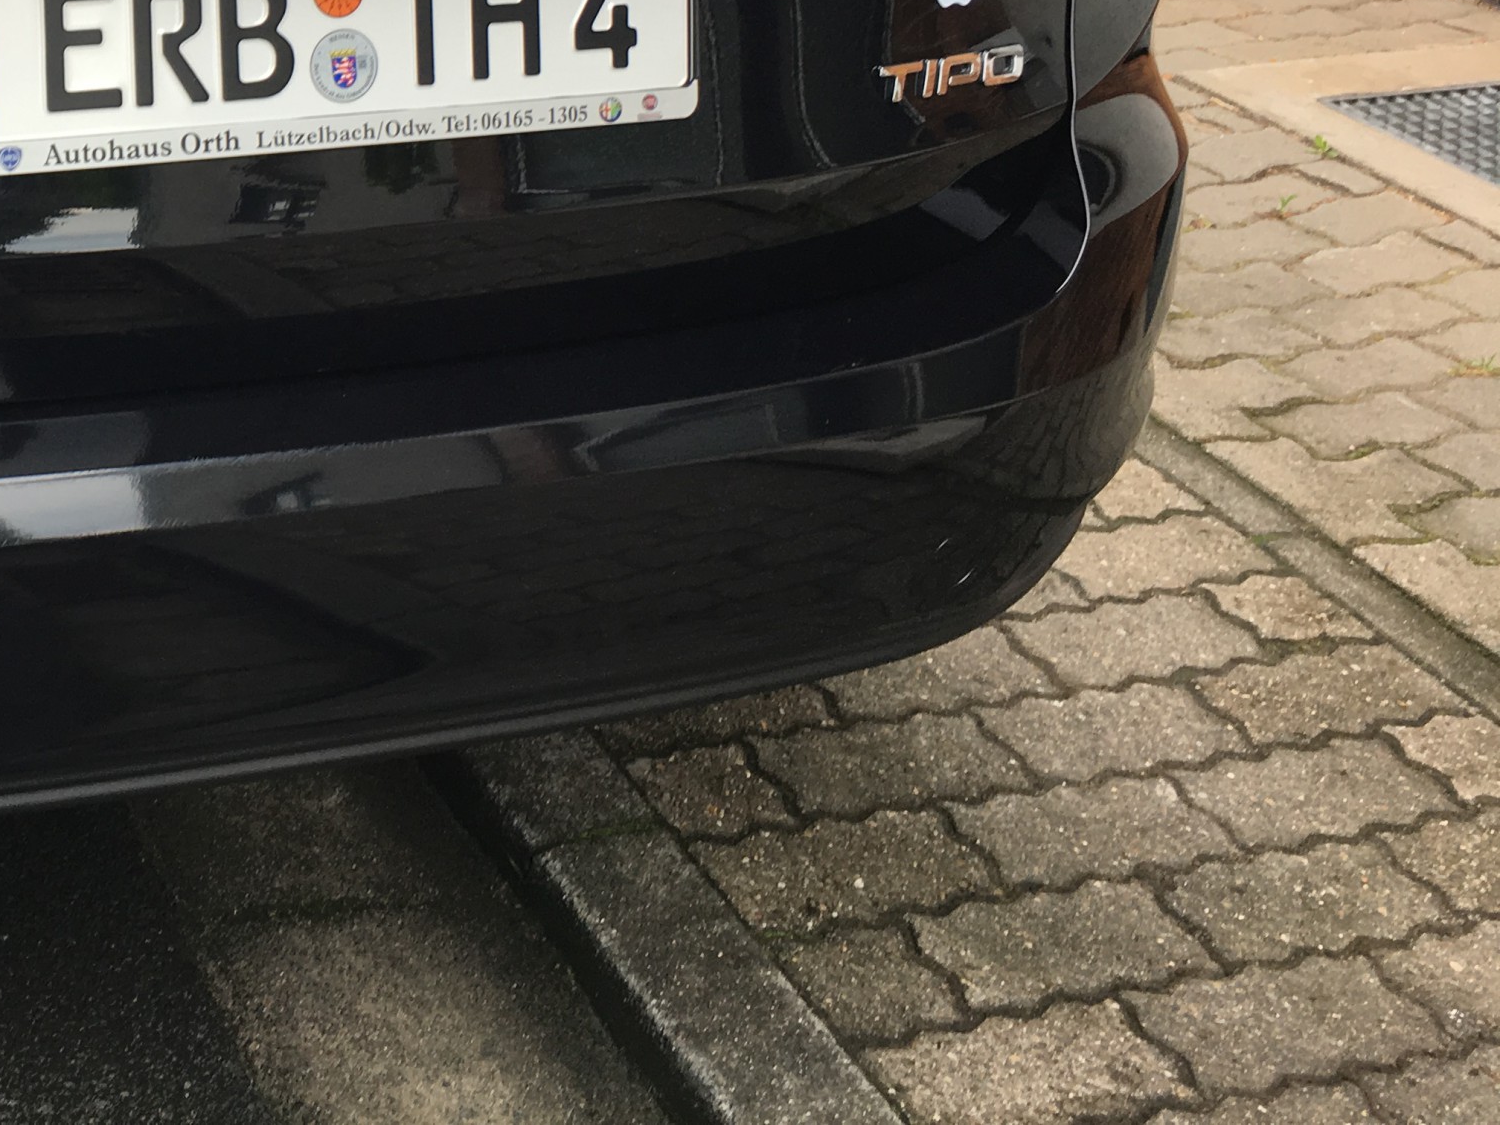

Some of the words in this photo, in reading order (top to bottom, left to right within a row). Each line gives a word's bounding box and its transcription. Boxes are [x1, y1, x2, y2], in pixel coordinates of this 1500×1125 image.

[878, 43, 1025, 103] TIPO
[43, 139, 172, 167] Autohaus
[180, 131, 241, 155] Orth
